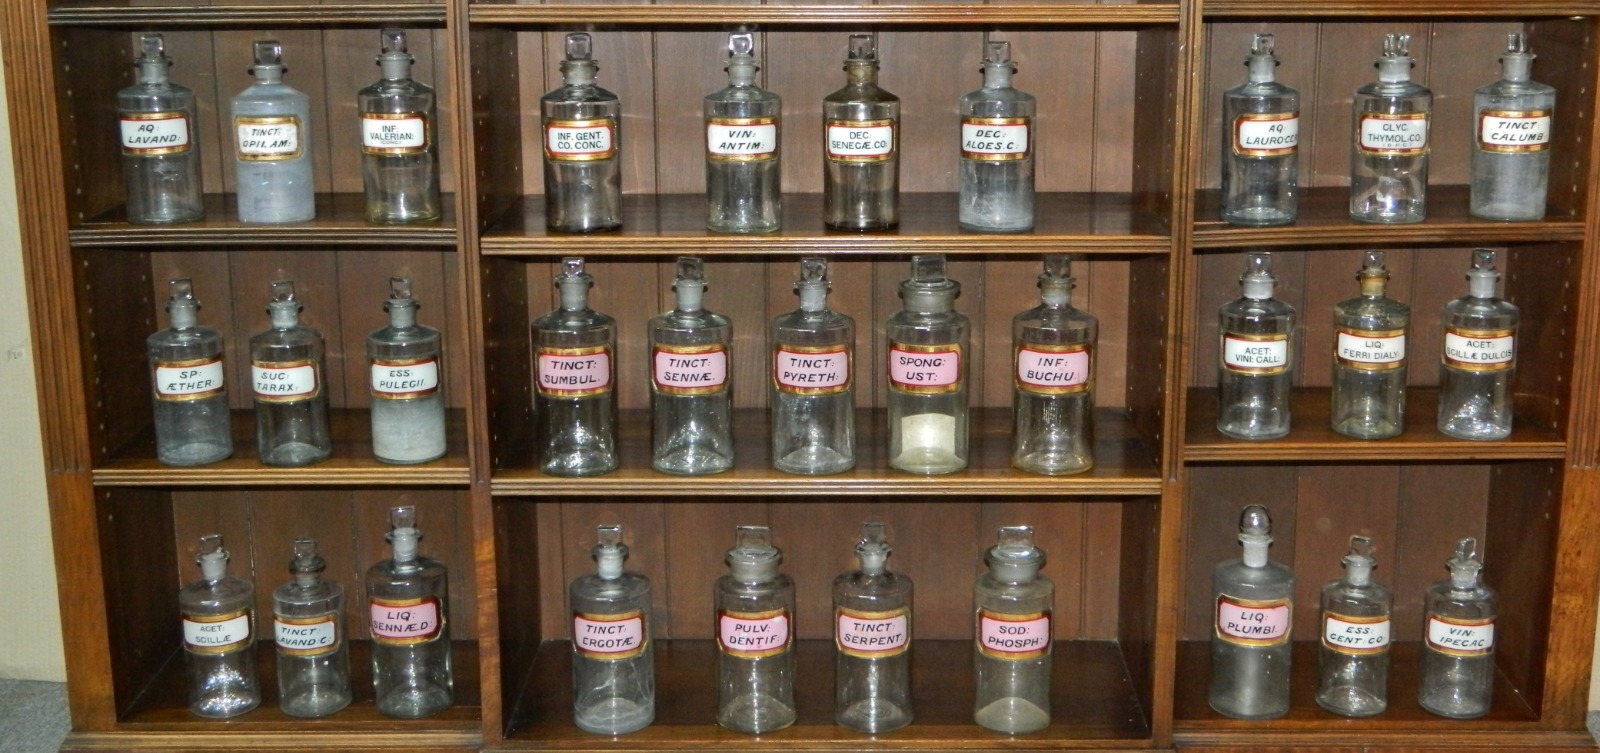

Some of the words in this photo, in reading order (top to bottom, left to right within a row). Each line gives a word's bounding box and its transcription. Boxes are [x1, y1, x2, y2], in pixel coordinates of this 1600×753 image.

[252, 128, 281, 136] TINCT:
[382, 125, 399, 133] INF:
[729, 130, 757, 138] VIN:
[976, 129, 1005, 138] DEC:
[128, 134, 181, 144] LAVAND:
[370, 132, 414, 140] VALERIAN:
[558, 132, 573, 140] INF.
[576, 131, 603, 140] GENT.
[849, 131, 871, 139] DEC:
[269, 139, 292, 148] AM:
[558, 141, 572, 149] CO.
[575, 141, 604, 149] CONC.
[719, 142, 764, 150] ANTIM:
[1365, 340, 1384, 349] LIQ:
[1466, 340, 1494, 348] ACET:
[1245, 347, 1272, 355] ACET:
[1343, 349, 1371, 359] FERRI
[551, 360, 597, 370] TINCT:
[669, 358, 711, 368] TINCT:
[790, 358, 834, 368] TINCT:
[899, 356, 946, 367] SPONG:
[1038, 357, 1068, 367] INF:
[179, 370, 201, 379] SP:
[261, 372, 289, 380] SUC:
[544, 374, 600, 384] SUMBUL.
[783, 371, 838, 382] PYRETH:
[906, 371, 937, 381] UST:
[167, 379, 215, 391] ÆTHER:
[387, 611, 416, 621] LIQ:
[1240, 611, 1268, 623] LIQ:
[282, 627, 320, 635] TINCT:
[586, 624, 626, 634] TINCT:
[735, 624, 770, 633] PULV:
[853, 622, 895, 632] TINCT:
[998, 625, 1029, 635] SOD:
[1346, 626, 1374, 634] ESS:
[1449, 627, 1475, 637] VIN:
[195, 634, 232, 643] SCILLÆ
[729, 635, 780, 645] DENTIF:
[844, 633, 903, 646] SERPENT:
[988, 636, 1042, 648] PHOSPH:
